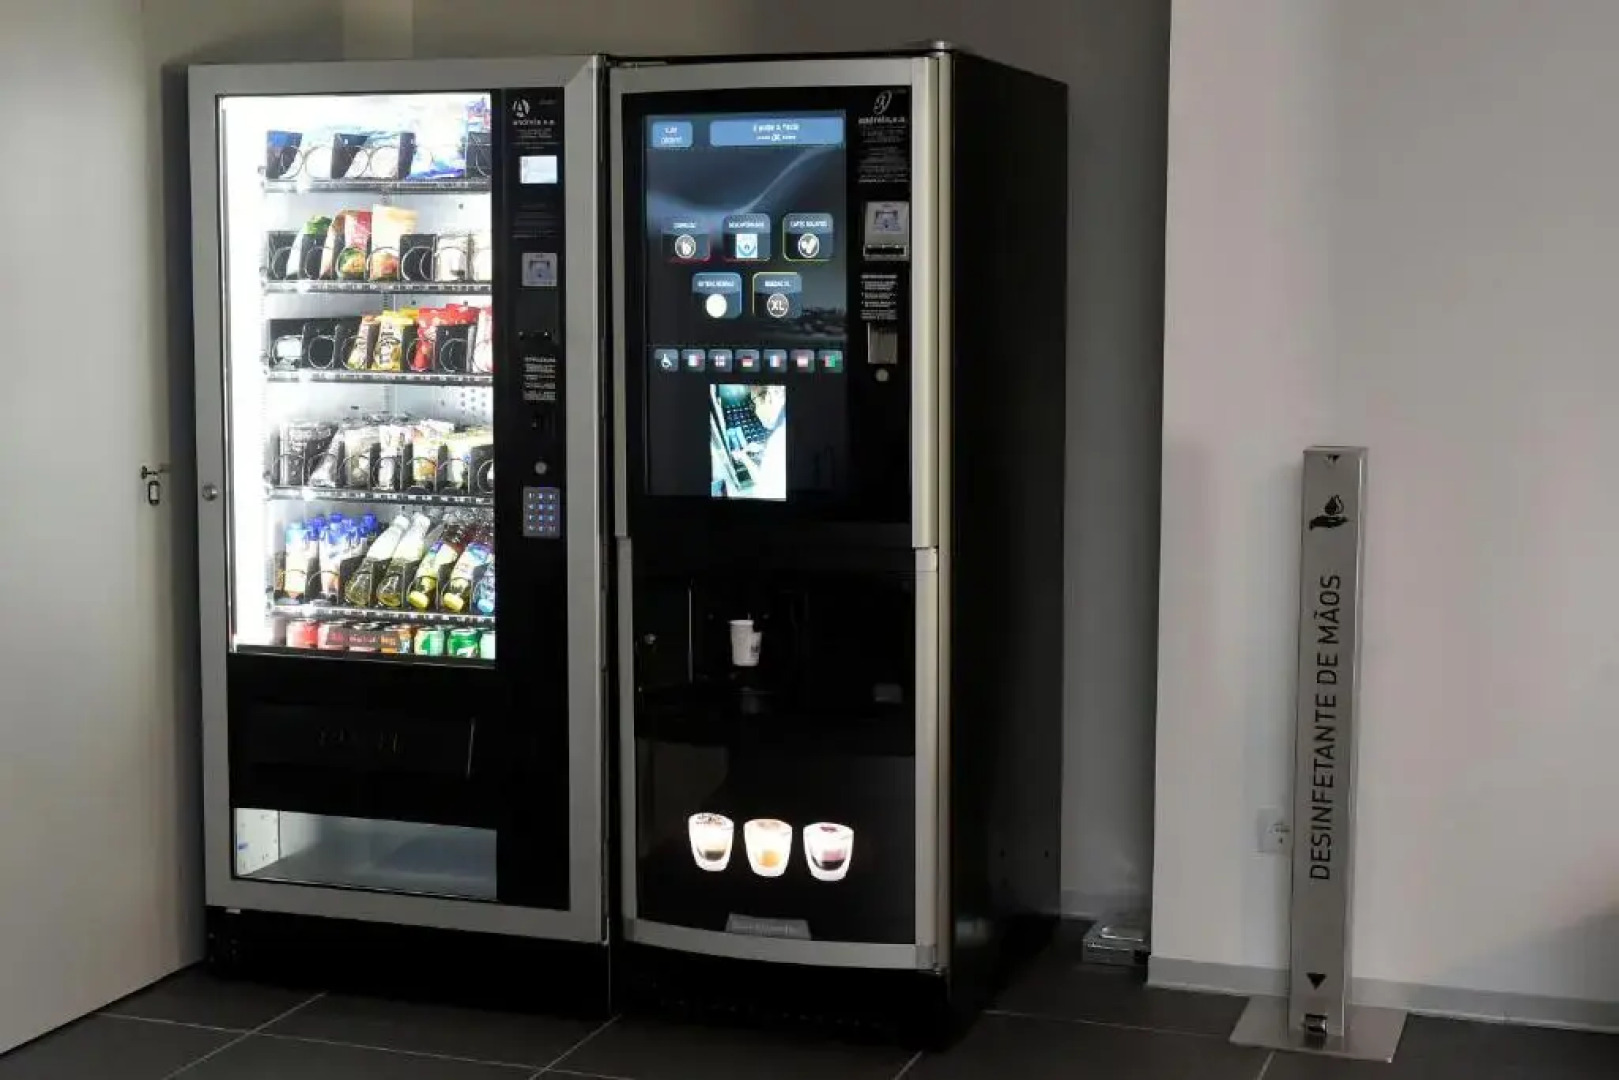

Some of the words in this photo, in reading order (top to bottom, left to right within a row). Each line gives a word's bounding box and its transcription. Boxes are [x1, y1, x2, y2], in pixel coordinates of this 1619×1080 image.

[771, 300, 785, 311] XL
[1314, 574, 1341, 644] MÃOS
[1316, 652, 1338, 684] DE
[1309, 693, 1336, 880] DESINFETANTE
